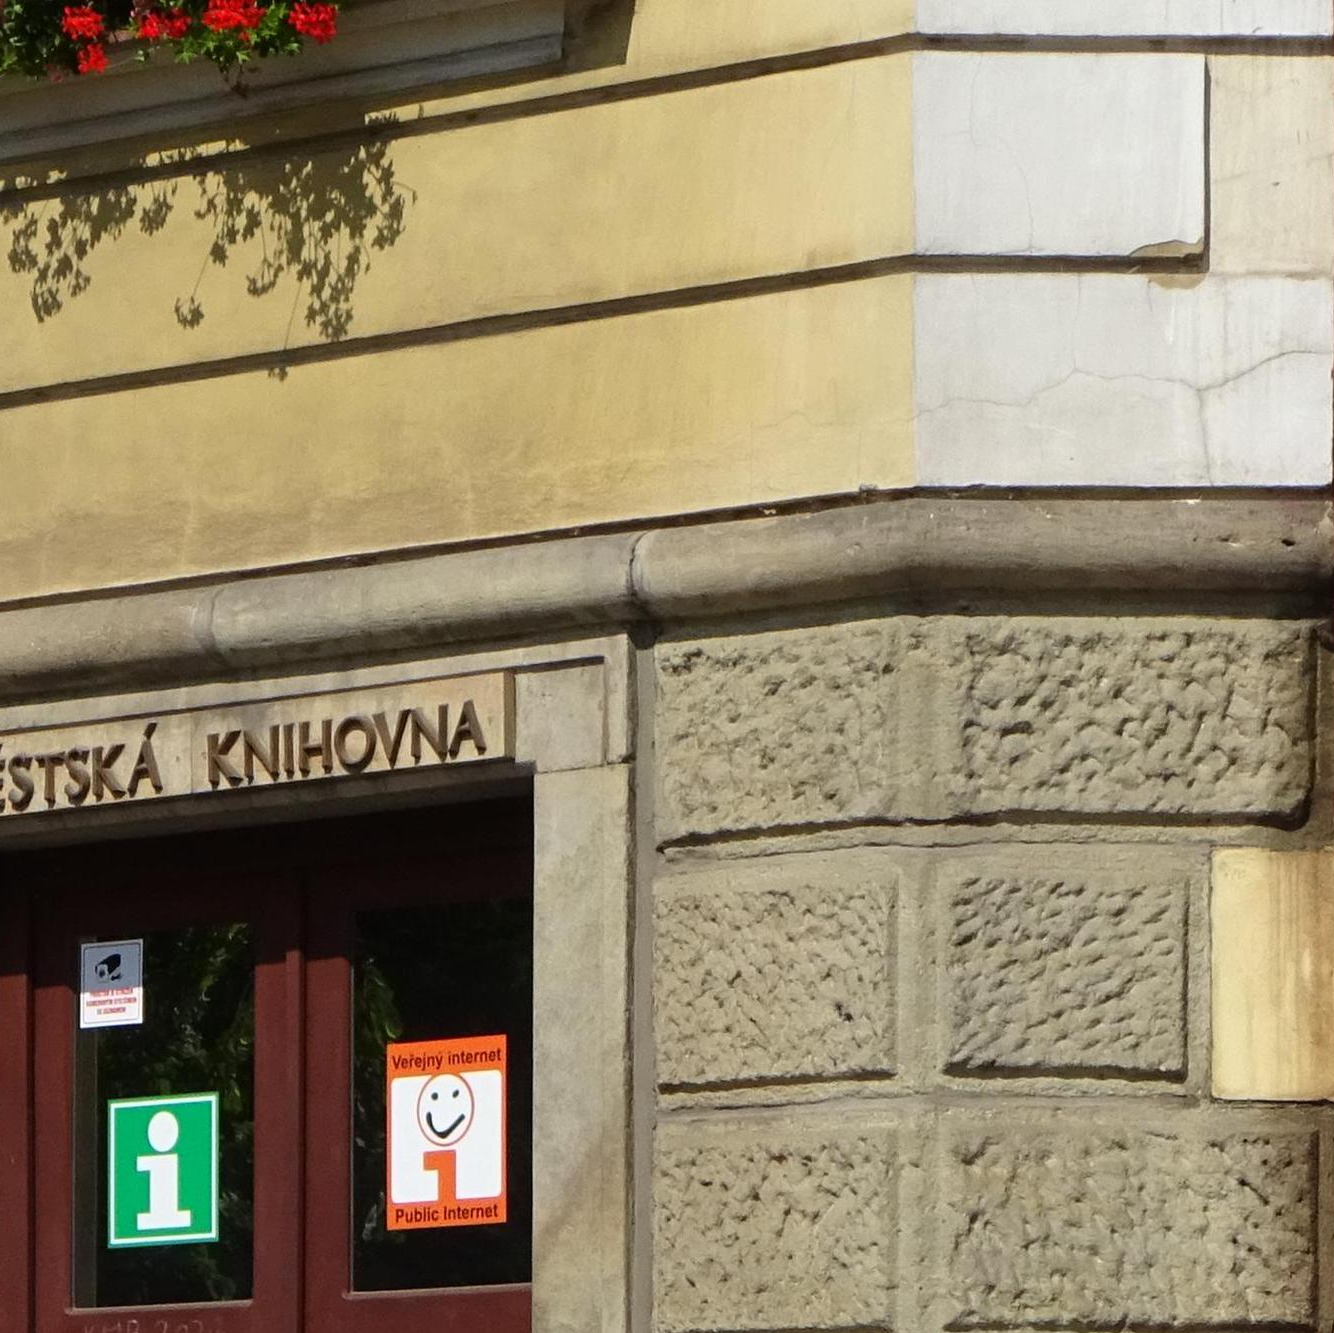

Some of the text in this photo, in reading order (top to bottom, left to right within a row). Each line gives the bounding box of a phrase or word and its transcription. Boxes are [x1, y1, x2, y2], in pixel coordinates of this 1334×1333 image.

[207, 699, 487, 790] KNIHOVNA
[392, 1047, 502, 1071] Veřejný internet
[395, 1203, 498, 1224] Public Internet
